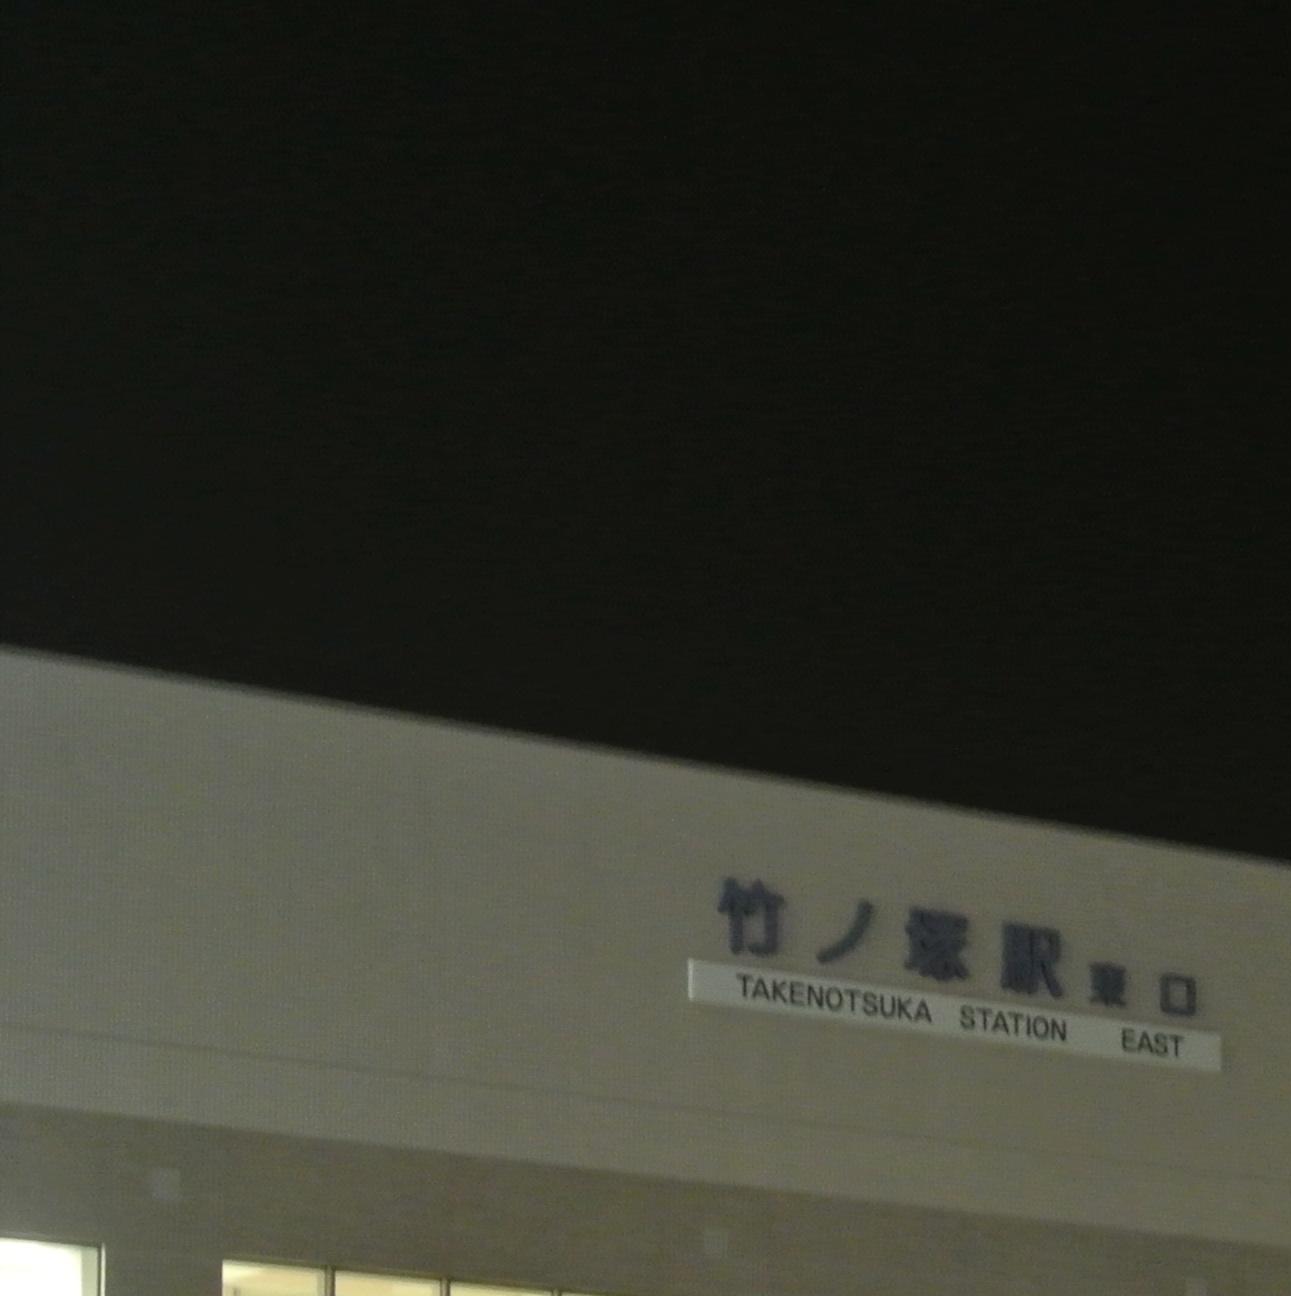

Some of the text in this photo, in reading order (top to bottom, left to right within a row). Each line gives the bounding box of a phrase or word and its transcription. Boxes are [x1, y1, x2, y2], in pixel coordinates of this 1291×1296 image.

[736, 973, 1184, 1058] TAKENOTSUKA STATION EAST
